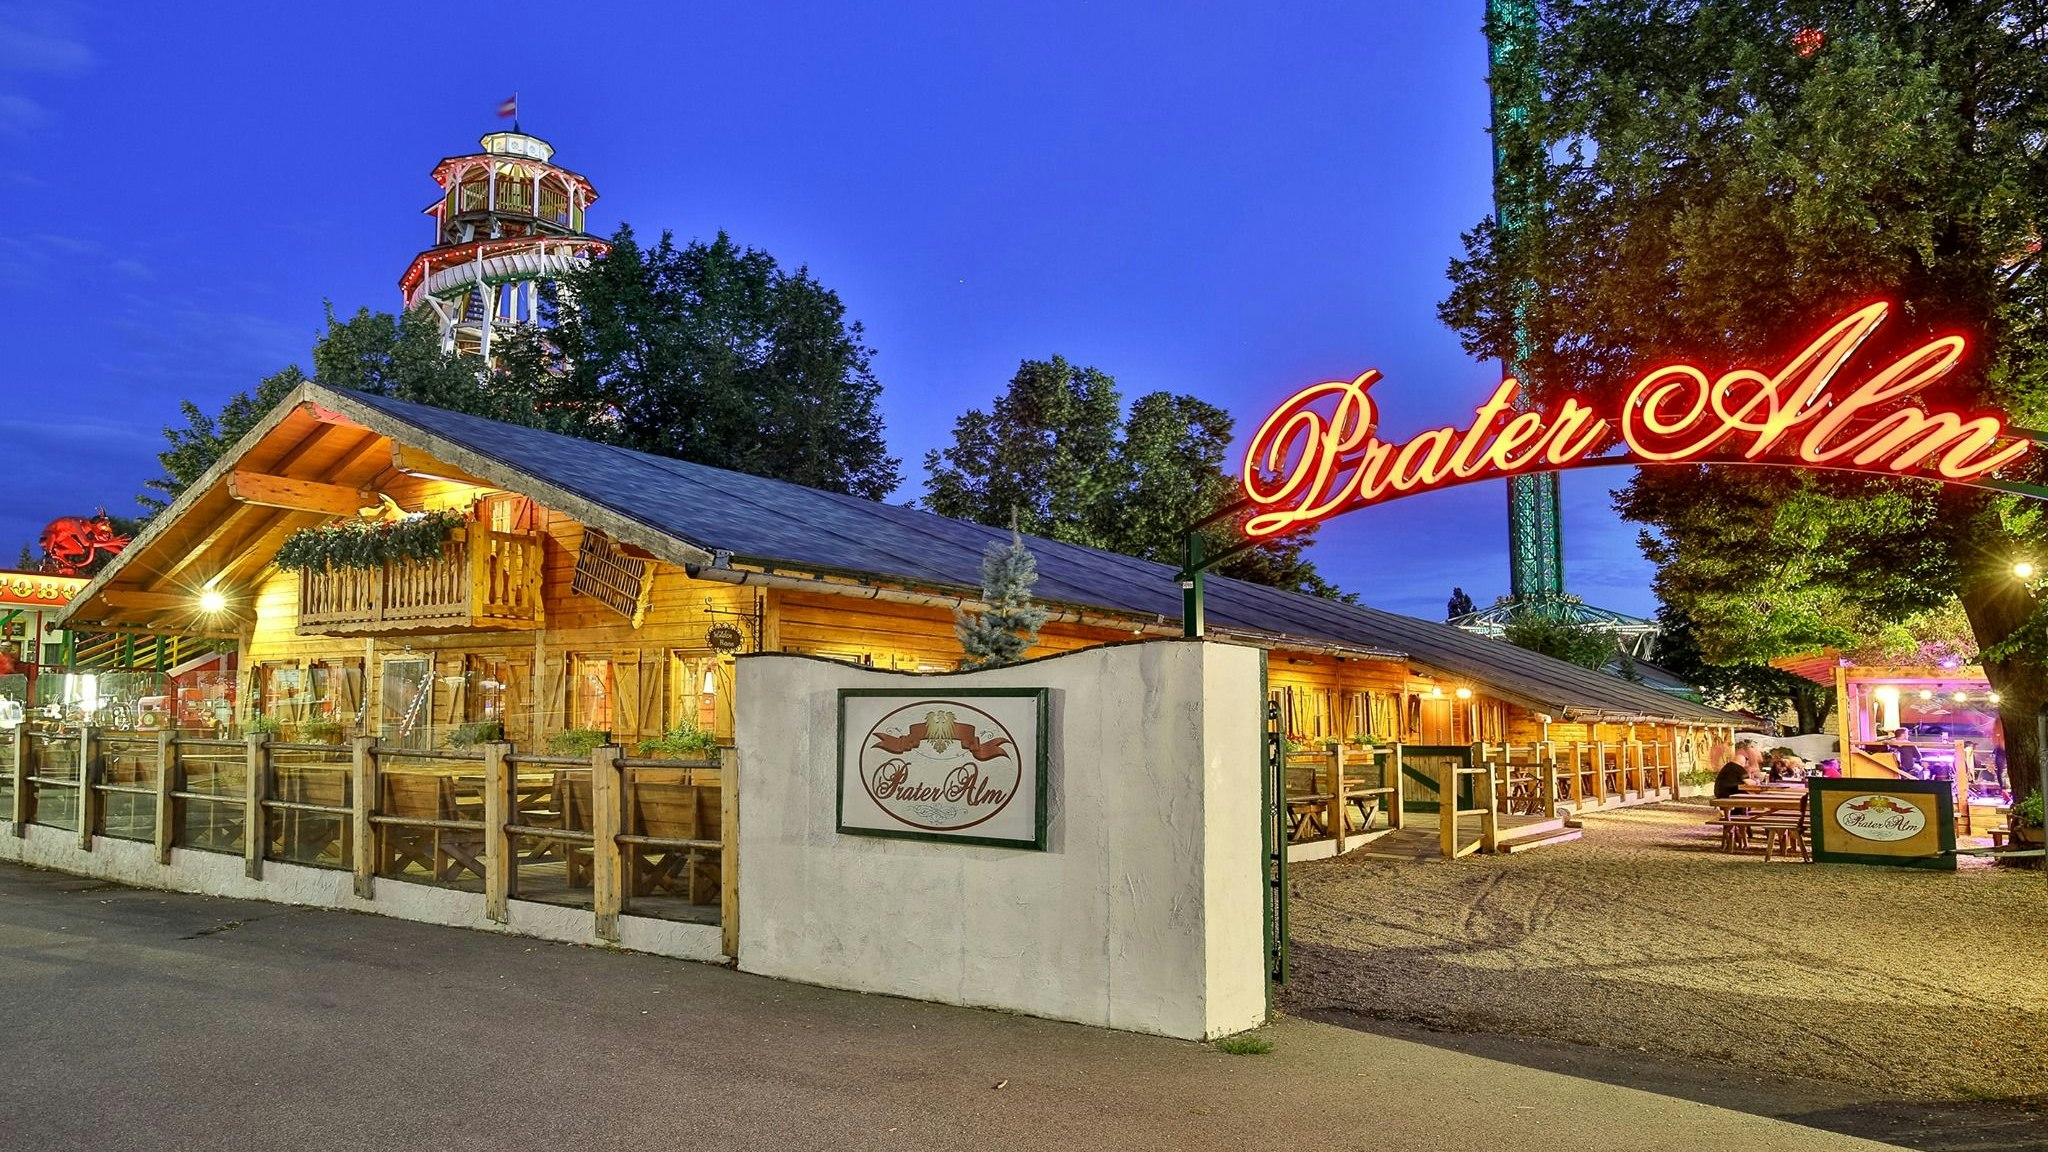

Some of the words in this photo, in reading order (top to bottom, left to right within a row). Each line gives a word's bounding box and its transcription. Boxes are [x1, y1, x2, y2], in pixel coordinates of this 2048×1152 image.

[1243, 369, 1608, 537] Prater
[1622, 300, 2031, 479] Alm
[871, 758, 945, 802] Prater
[943, 761, 1008, 807] Alm
[1842, 811, 1885, 829] Prater
[1884, 814, 1918, 831] Alm
